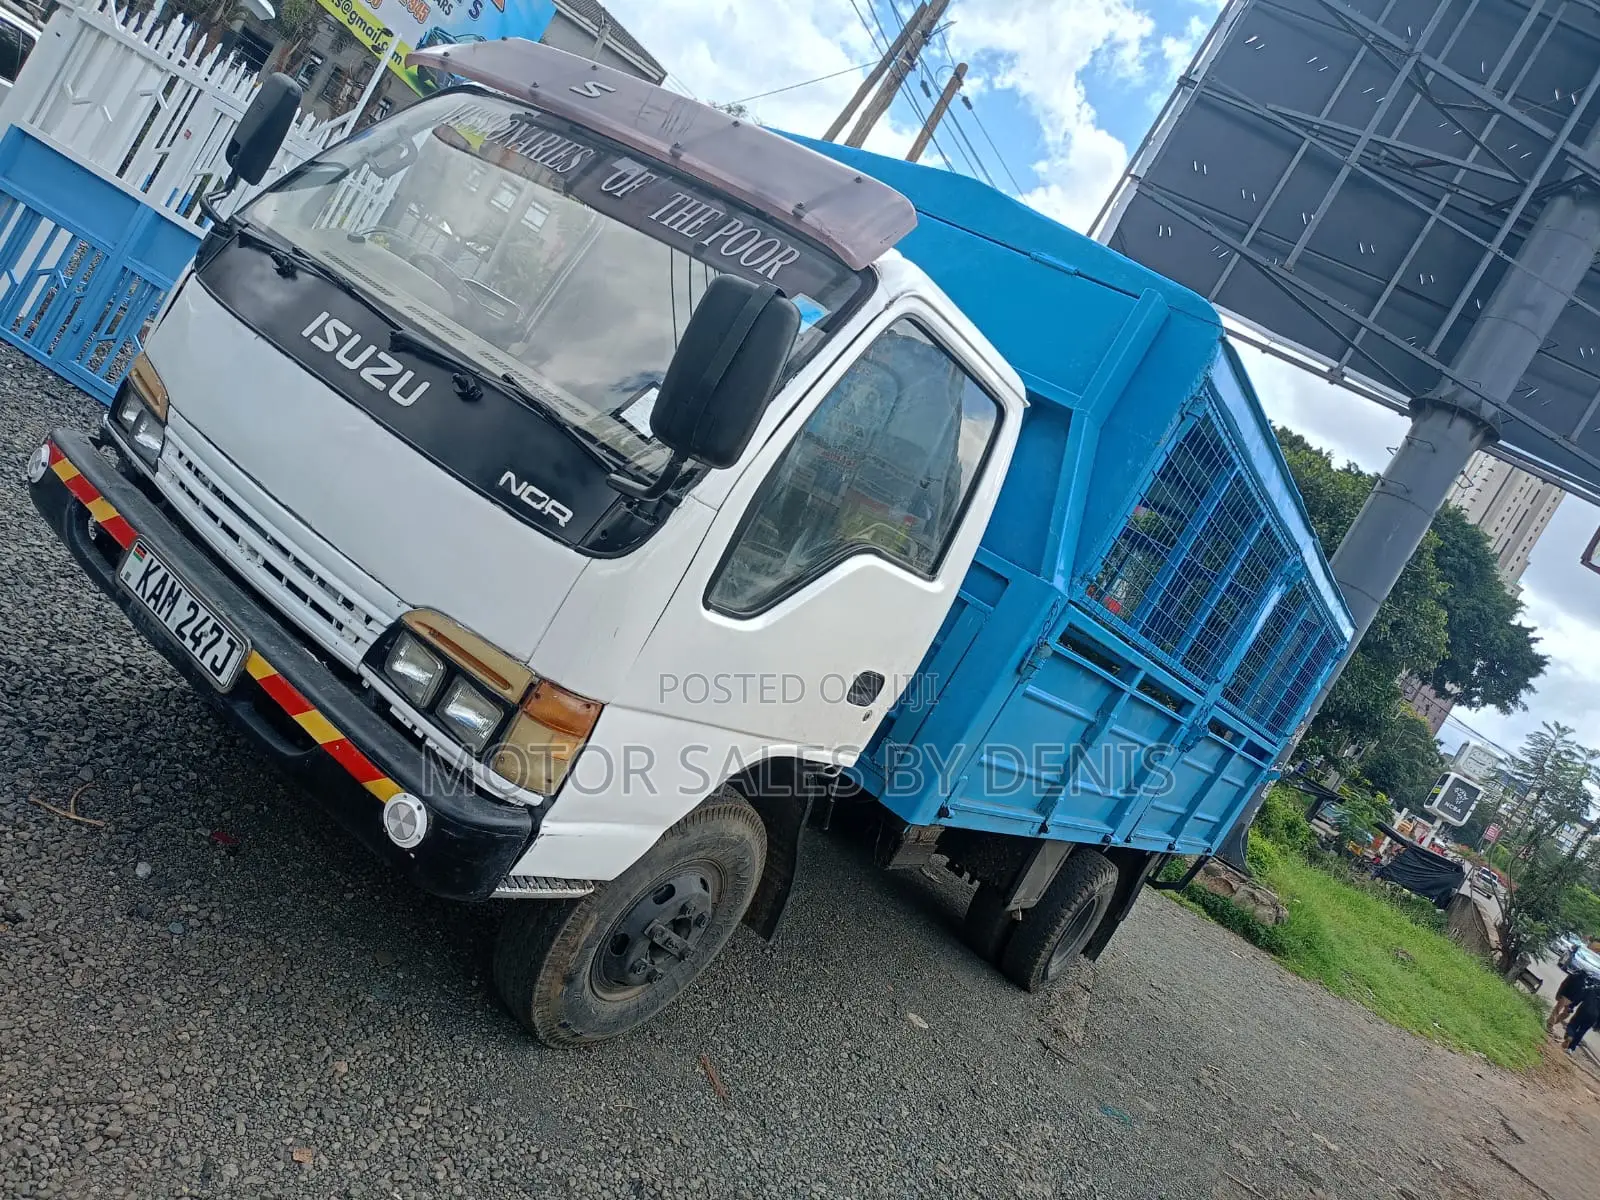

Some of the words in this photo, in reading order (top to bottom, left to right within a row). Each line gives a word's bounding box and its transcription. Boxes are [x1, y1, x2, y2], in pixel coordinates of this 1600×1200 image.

[601, 167, 657, 198] OF
[648, 192, 726, 239] THE
[700, 217, 801, 281] POOR
[301, 311, 431, 407] ISUZU
[498, 470, 574, 528] NQR
[135, 558, 183, 623] KAM
[174, 601, 238, 677] 247J
